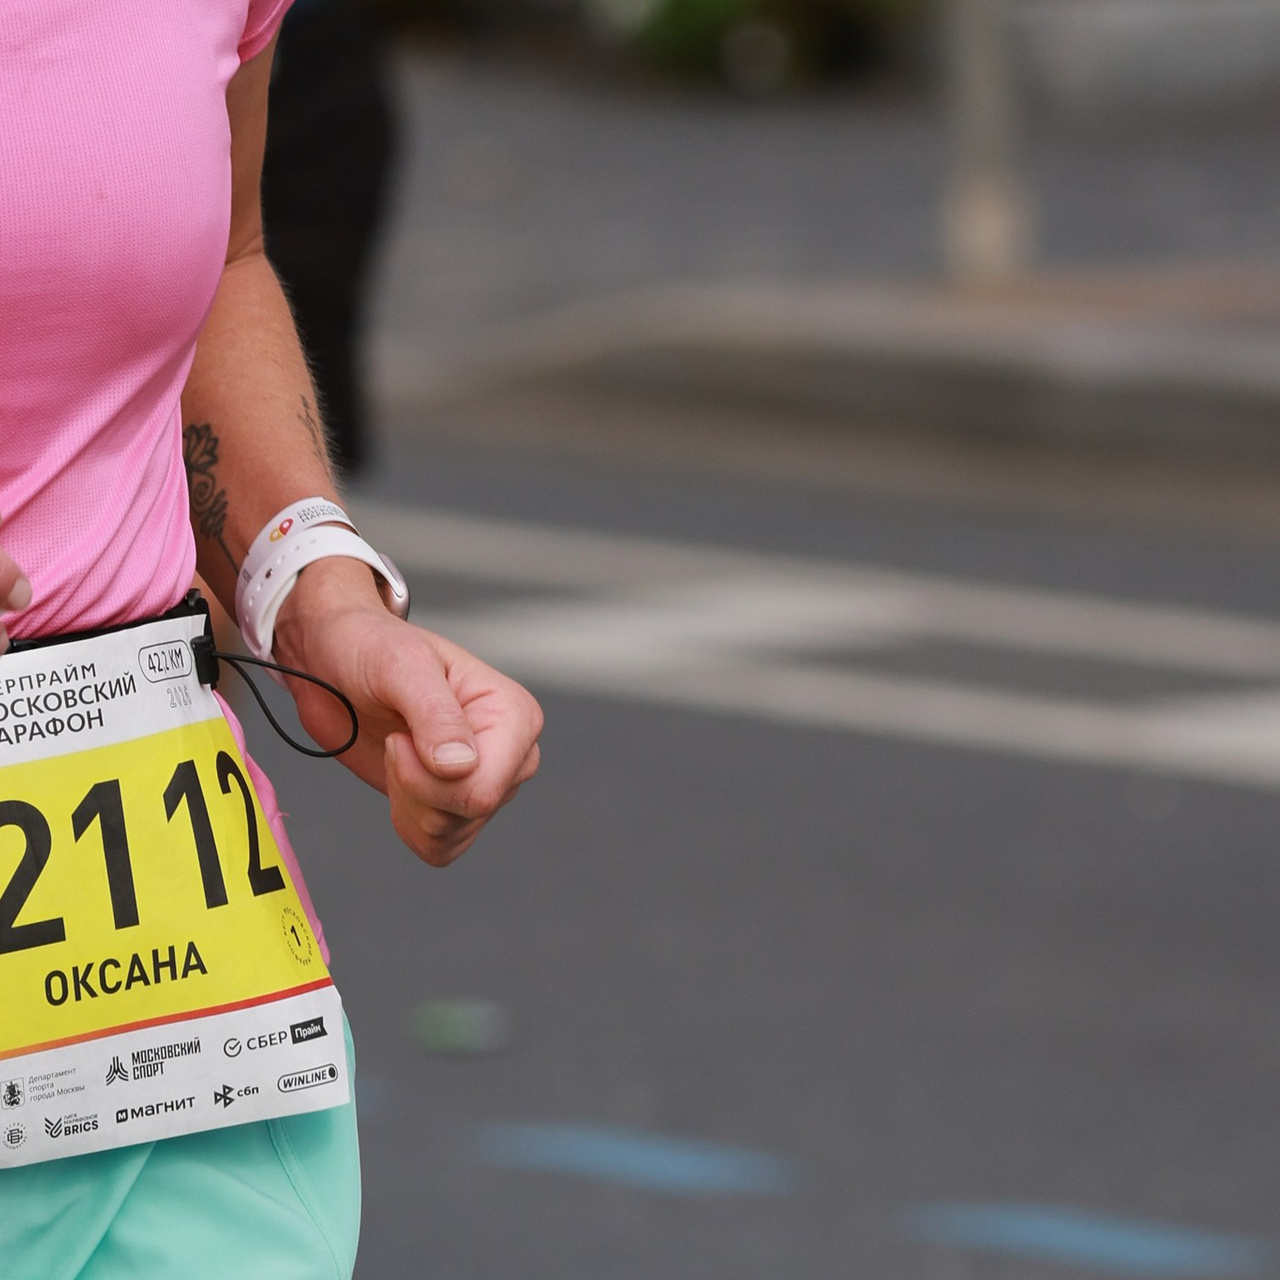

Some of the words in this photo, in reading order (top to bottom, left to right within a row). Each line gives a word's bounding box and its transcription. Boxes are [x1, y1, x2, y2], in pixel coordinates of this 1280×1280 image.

[290, 924, 302, 947] 1
[44, 941, 208, 1007] ОКСАНА
[246, 1030, 288, 1052] СБЕР
[294, 1023, 322, 1039] Прайм
[131, 1036, 202, 1066] МОСКОВСКИЙ
[28, 1068, 76, 1085] Департамент
[132, 1061, 165, 1081] СПОРТ
[282, 1069, 328, 1090] WINLINE
[29, 1082, 54, 1093] спорта
[29, 1092, 56, 1102] города
[56, 1085, 86, 1096] Москвы
[236, 1084, 260, 1098] сбп
[64, 1120, 99, 1136] BRICS
